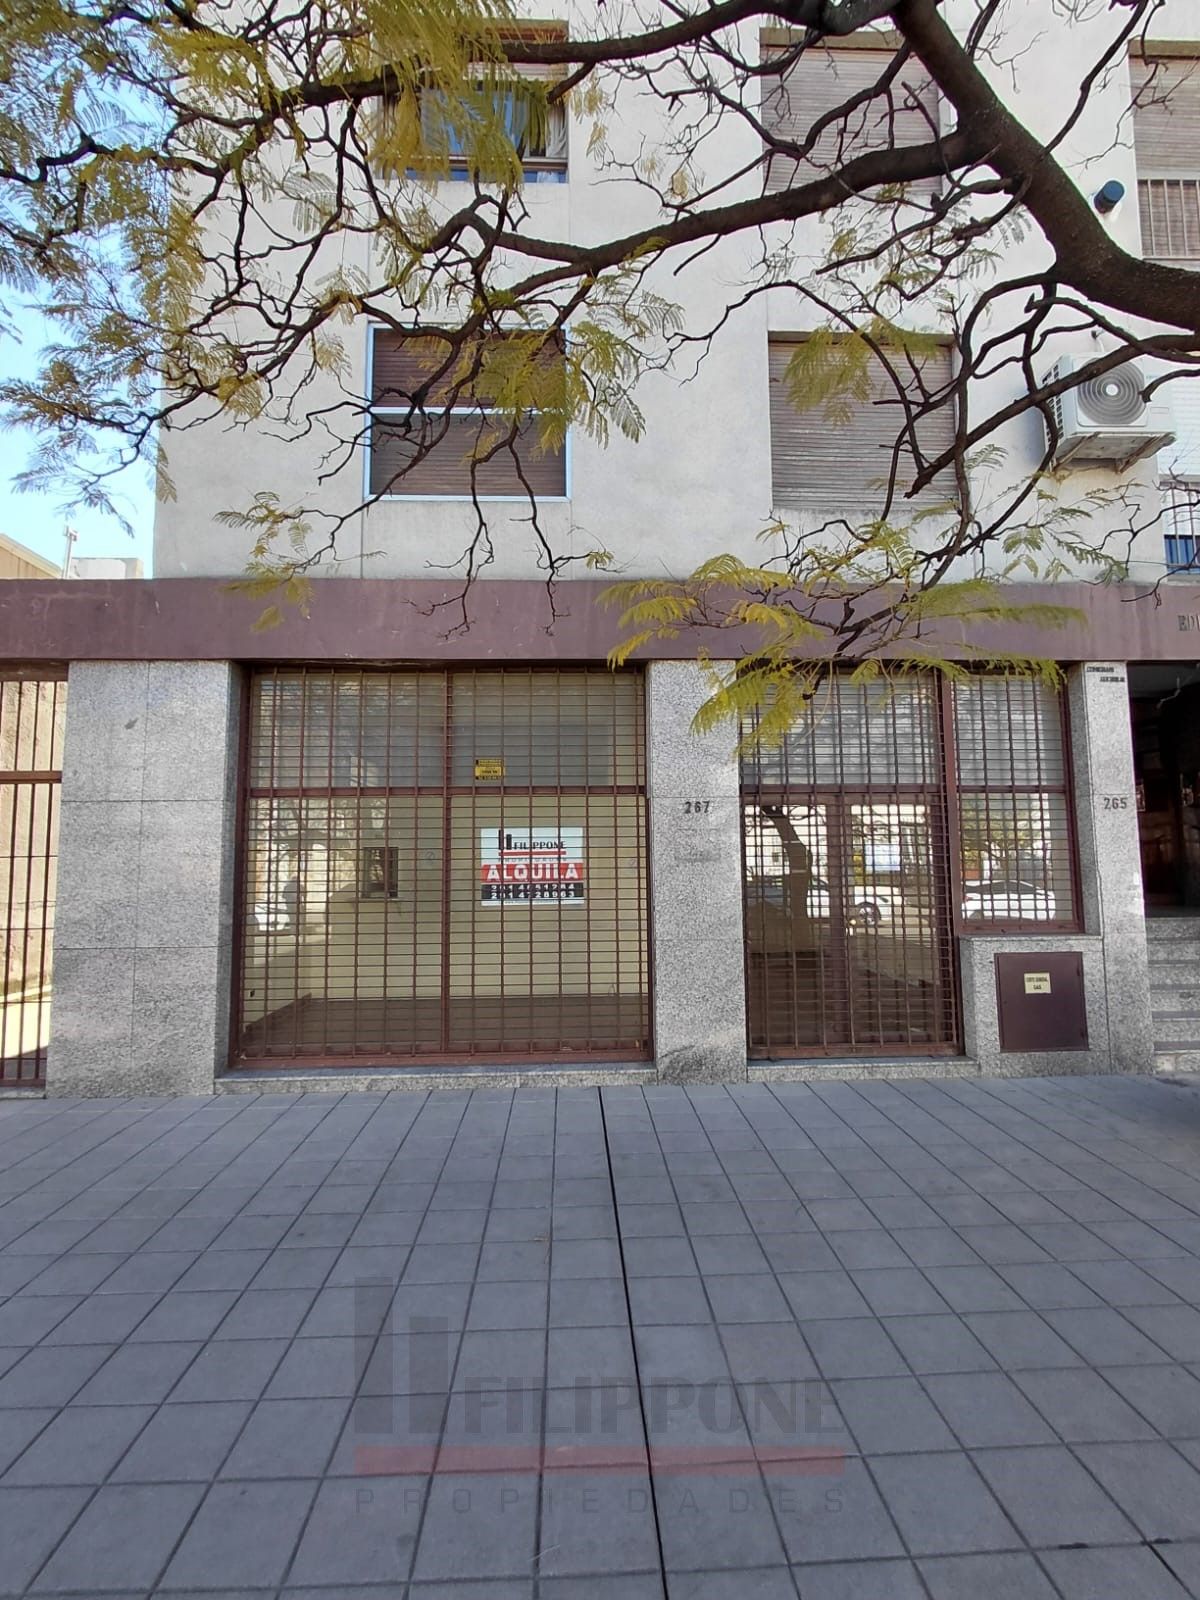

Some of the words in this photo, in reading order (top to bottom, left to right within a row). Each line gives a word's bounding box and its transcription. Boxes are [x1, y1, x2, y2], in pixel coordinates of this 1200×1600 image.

[684, 801, 710, 814] 267
[1103, 796, 1128, 810] 265
[513, 841, 567, 850] FILPPONE
[486, 863, 579, 881] ALQUILA
